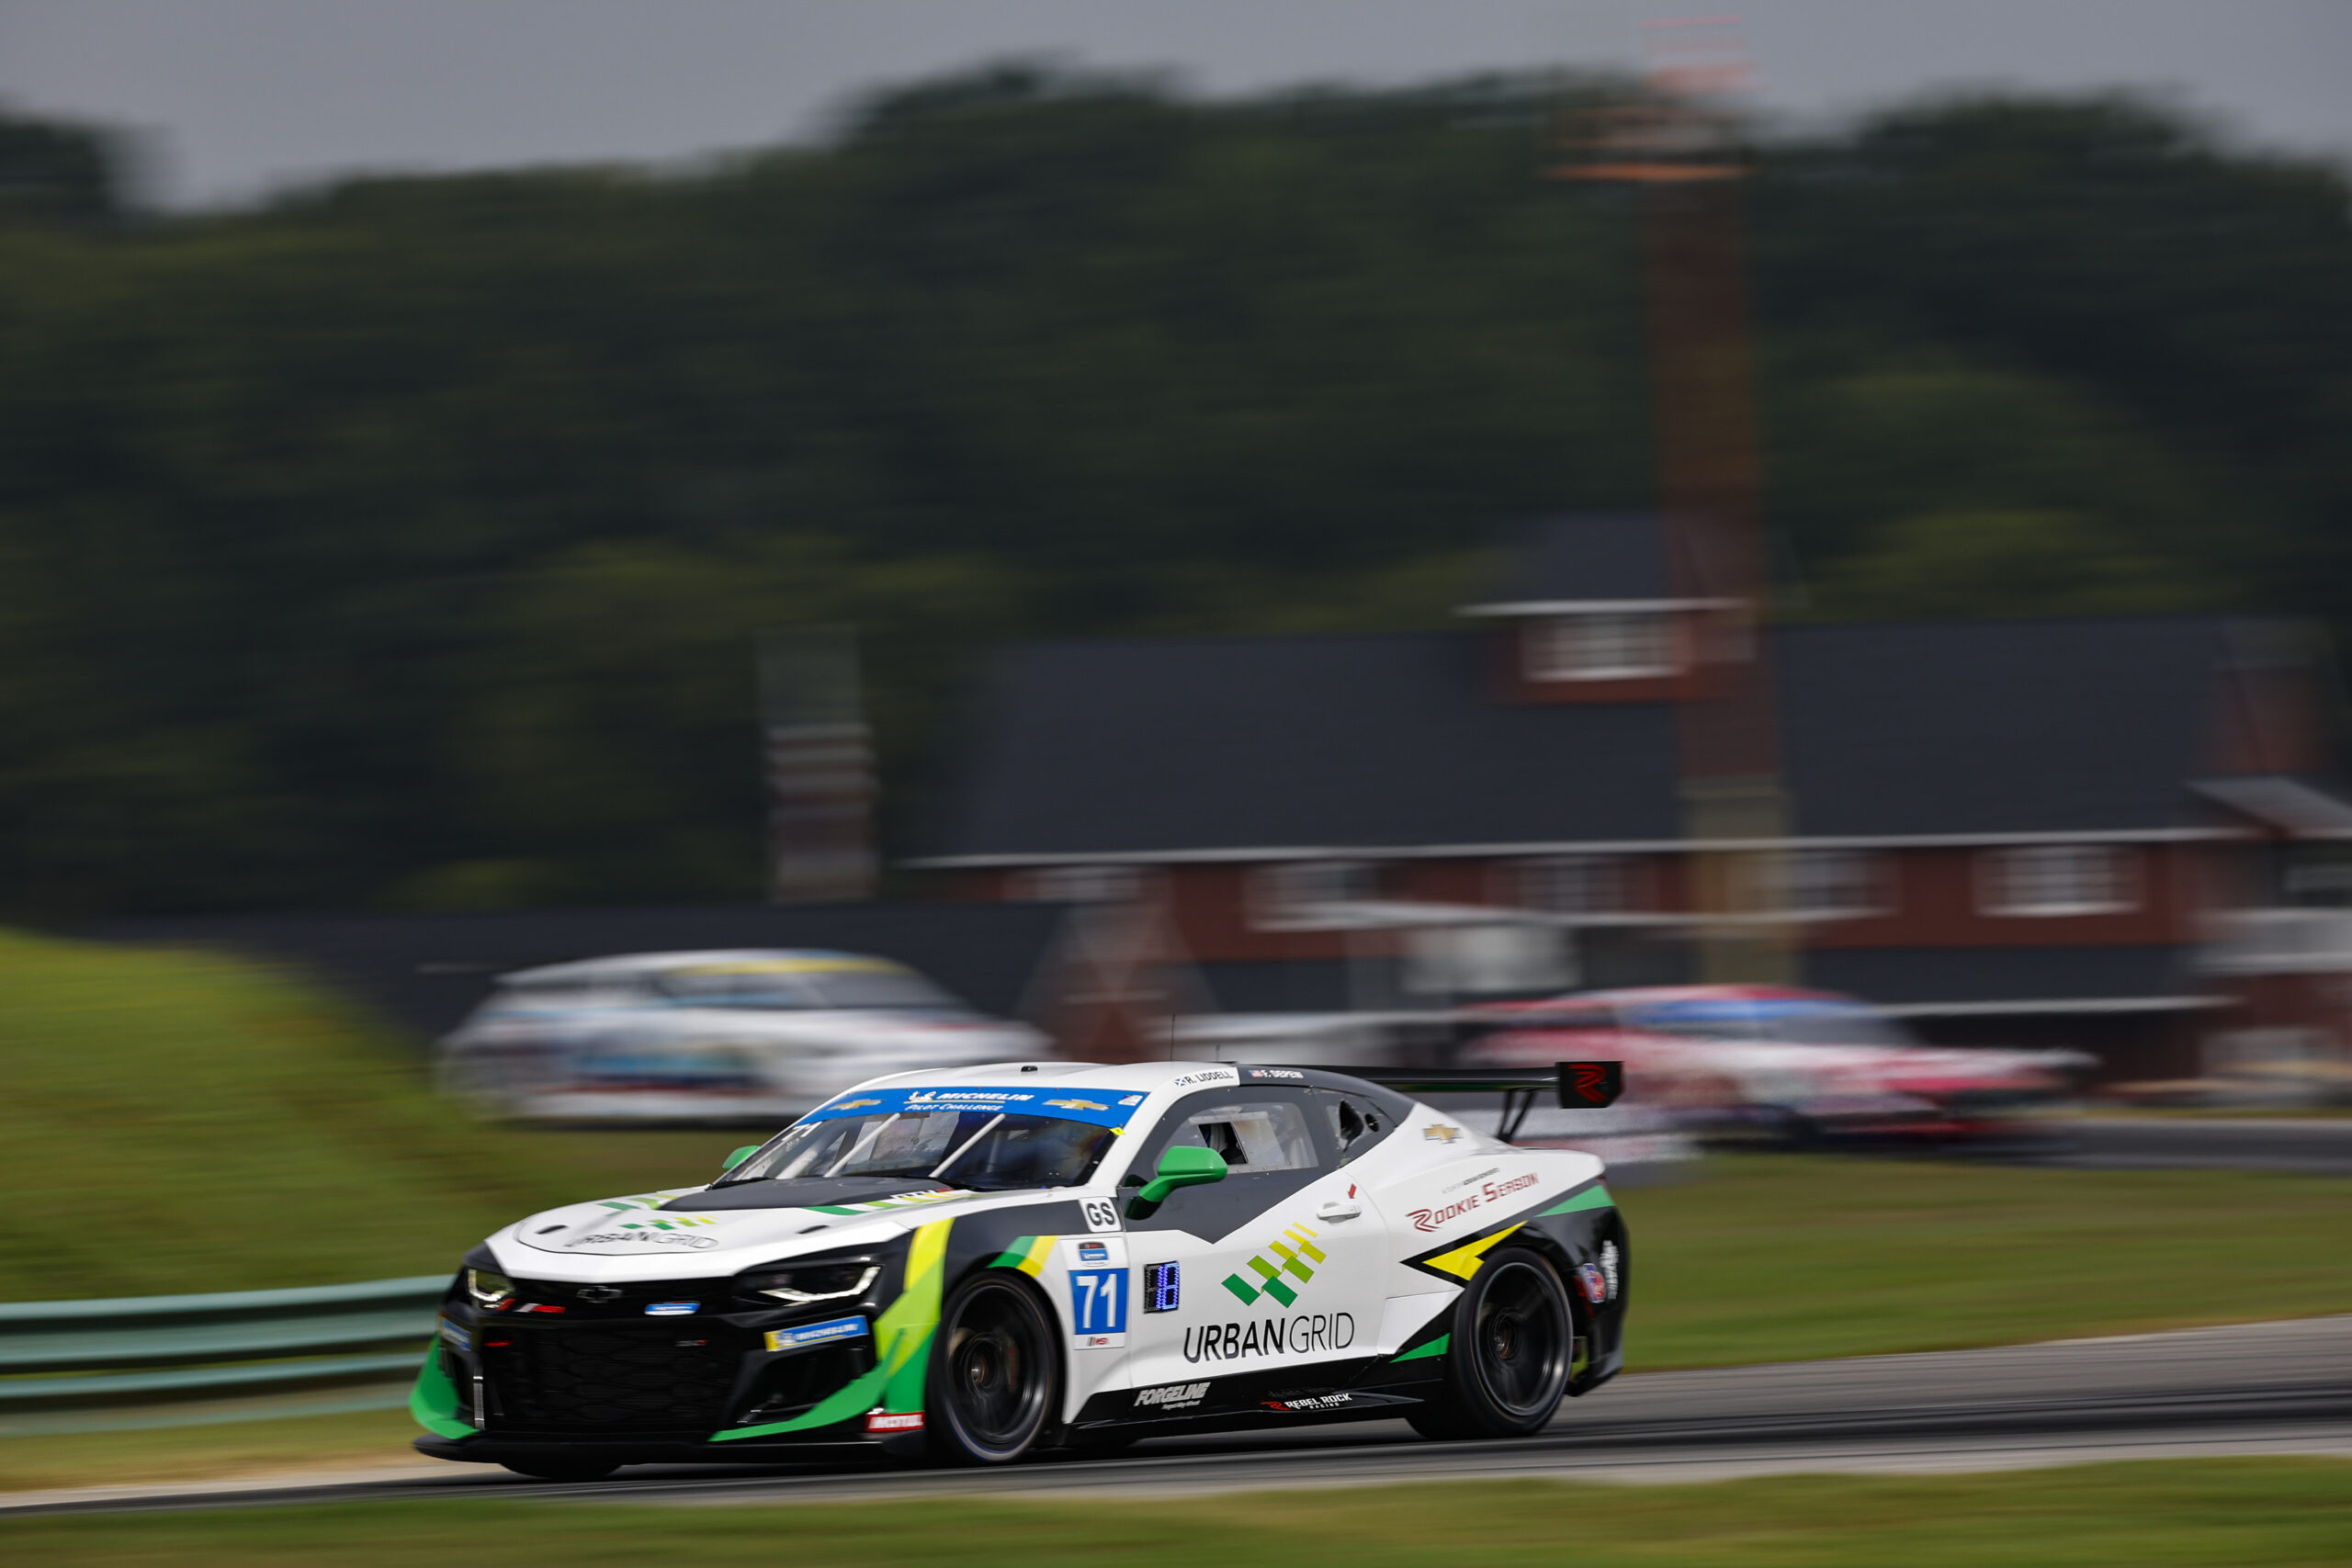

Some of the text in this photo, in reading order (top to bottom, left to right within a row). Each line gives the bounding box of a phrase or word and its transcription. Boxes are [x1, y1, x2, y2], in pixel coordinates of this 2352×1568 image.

[1184, 1072, 1234, 1084] R. LIDDELL
[935, 1091, 1035, 1101] MICHELIN
[939, 1103, 1004, 1111] CHALLENGE
[1086, 1202, 1115, 1226] GS
[1405, 1194, 1480, 1232] ROOKIE
[1076, 1273, 1117, 1329] 71
[1133, 1382, 1211, 1407] FORGELINE
[1284, 1393, 1352, 1410] REBEL ROCK
